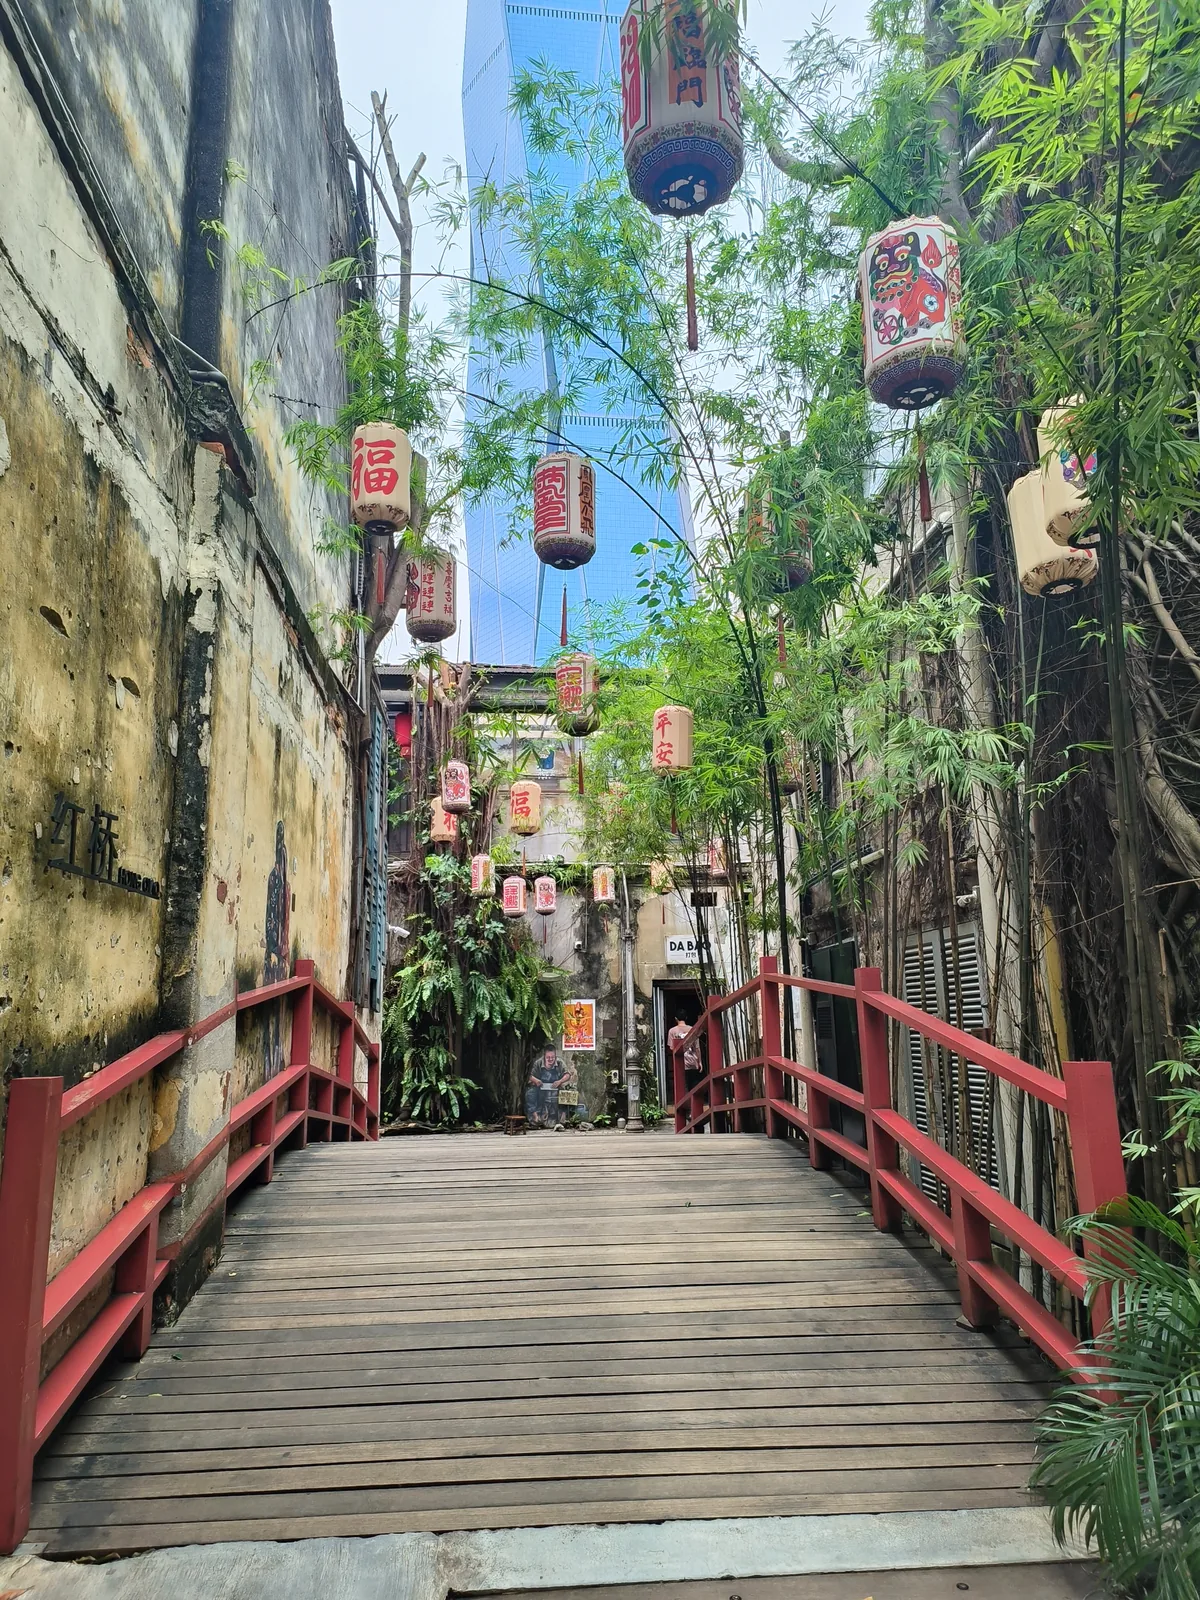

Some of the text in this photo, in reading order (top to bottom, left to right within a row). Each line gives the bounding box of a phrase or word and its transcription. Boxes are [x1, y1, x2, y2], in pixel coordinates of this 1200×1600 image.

[353, 437, 399, 501] 福
[655, 712, 674, 765] 平安
[118, 866, 142, 891] HONG
[669, 941, 685, 951] DA
